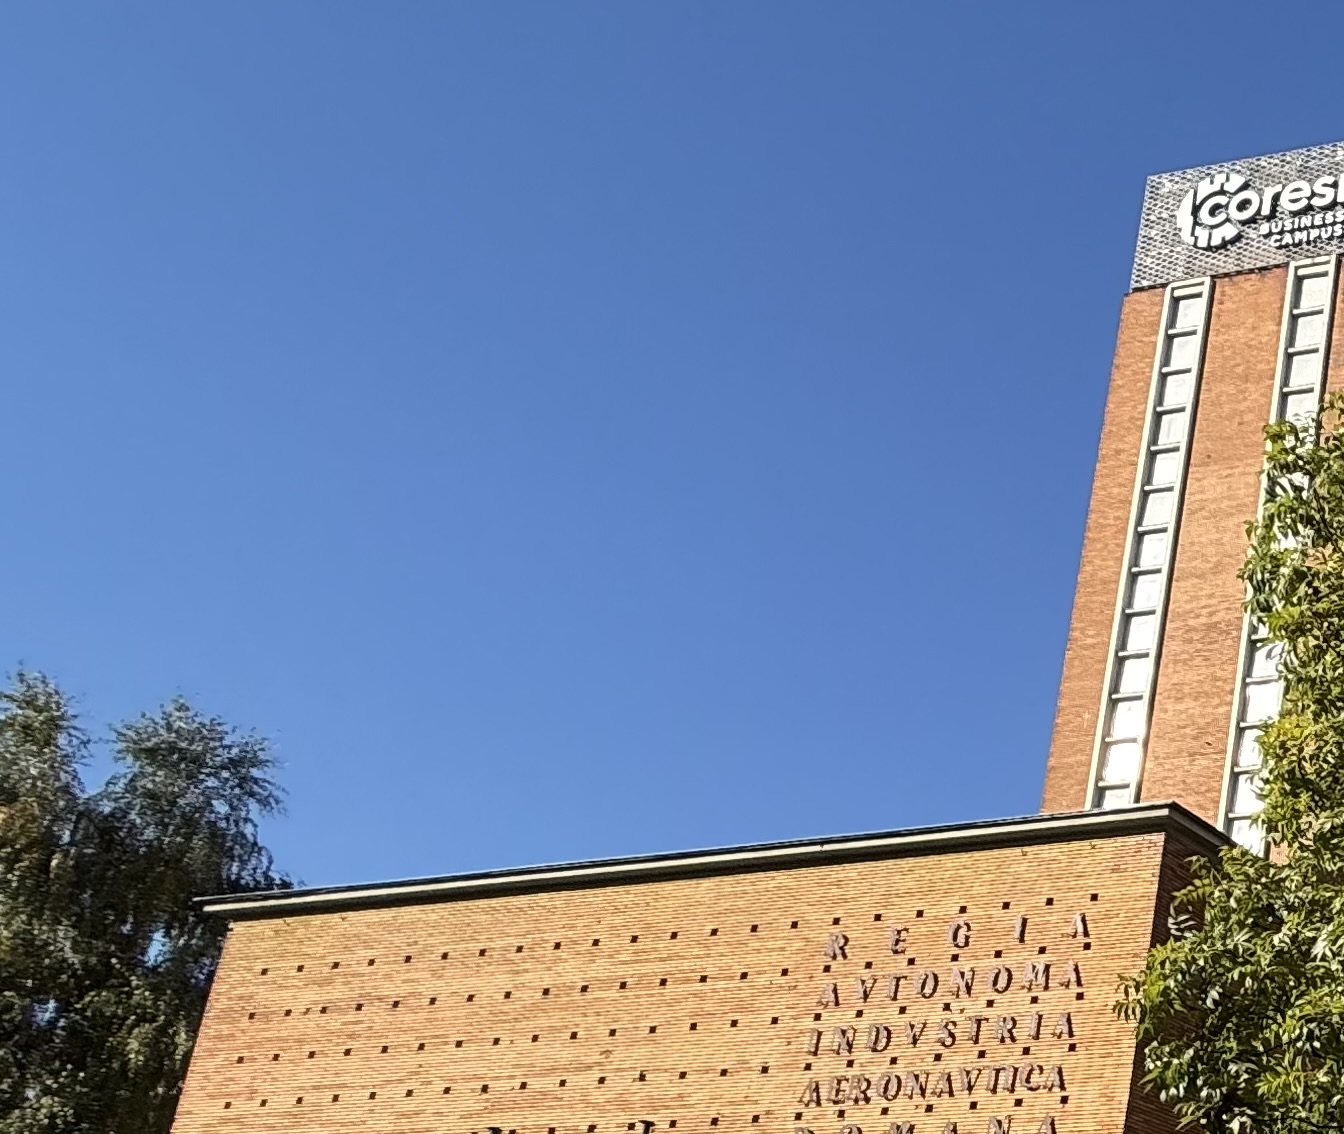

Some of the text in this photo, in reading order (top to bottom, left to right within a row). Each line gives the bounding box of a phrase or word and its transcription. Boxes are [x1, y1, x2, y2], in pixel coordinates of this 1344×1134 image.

[1260, 210, 1344, 235] BUSINESS
[1270, 223, 1343, 247] CAMPUS
[825, 912, 1091, 961] REGIA
[818, 960, 1084, 1009] AVTONOMA
[806, 1011, 1075, 1057] INDVSTRIA
[799, 1062, 1068, 1108] AERONAVTICA
